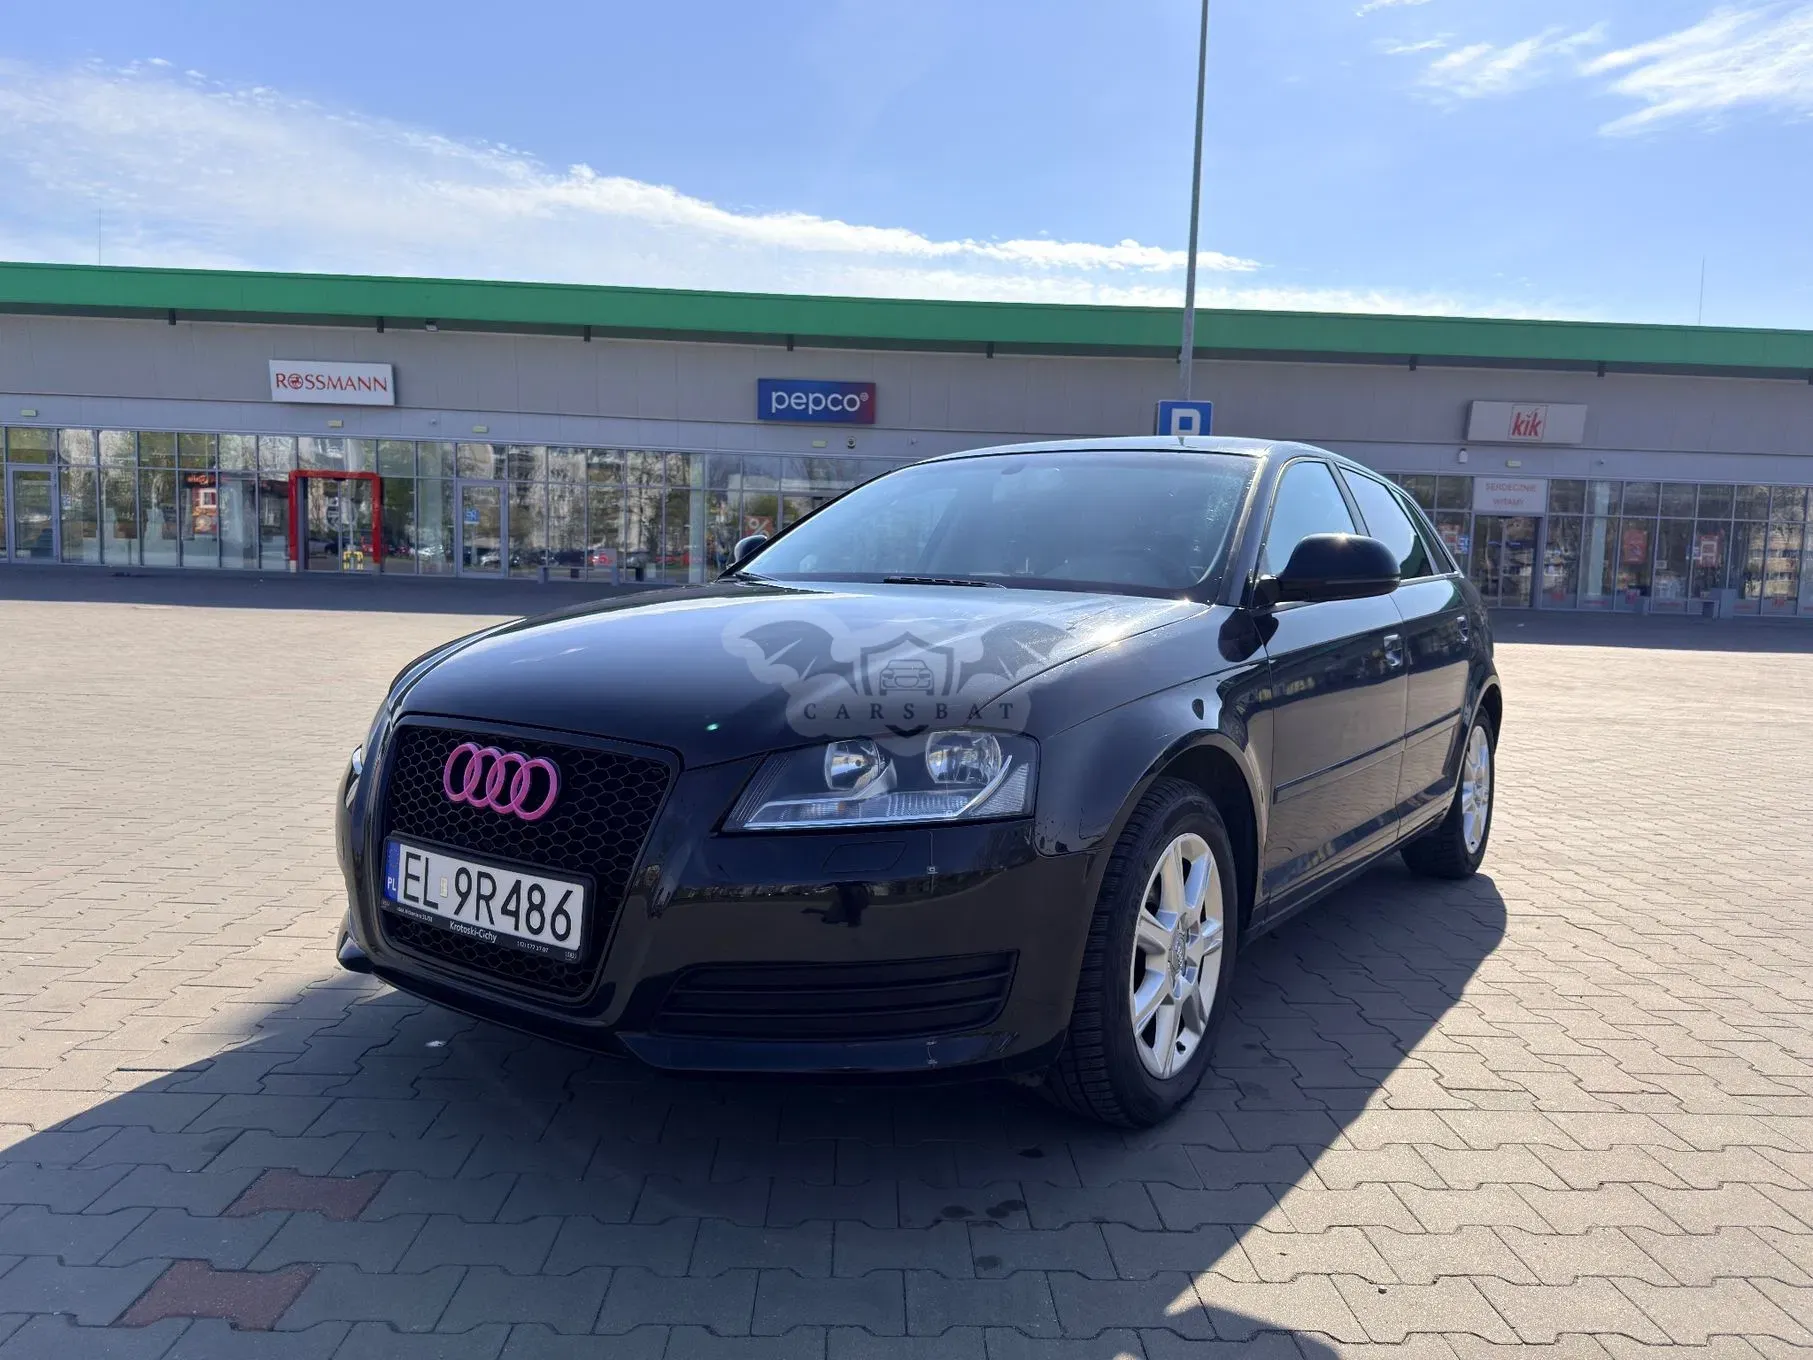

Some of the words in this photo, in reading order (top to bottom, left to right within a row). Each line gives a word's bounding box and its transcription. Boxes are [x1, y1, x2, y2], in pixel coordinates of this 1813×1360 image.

[275, 371, 389, 394] ROSSMANN
[771, 391, 861, 415] pepco
[387, 875, 397, 892] PL
[403, 851, 439, 910] EL
[453, 866, 574, 942] 9R486
[449, 920, 498, 944] Krotoski-Cichy
